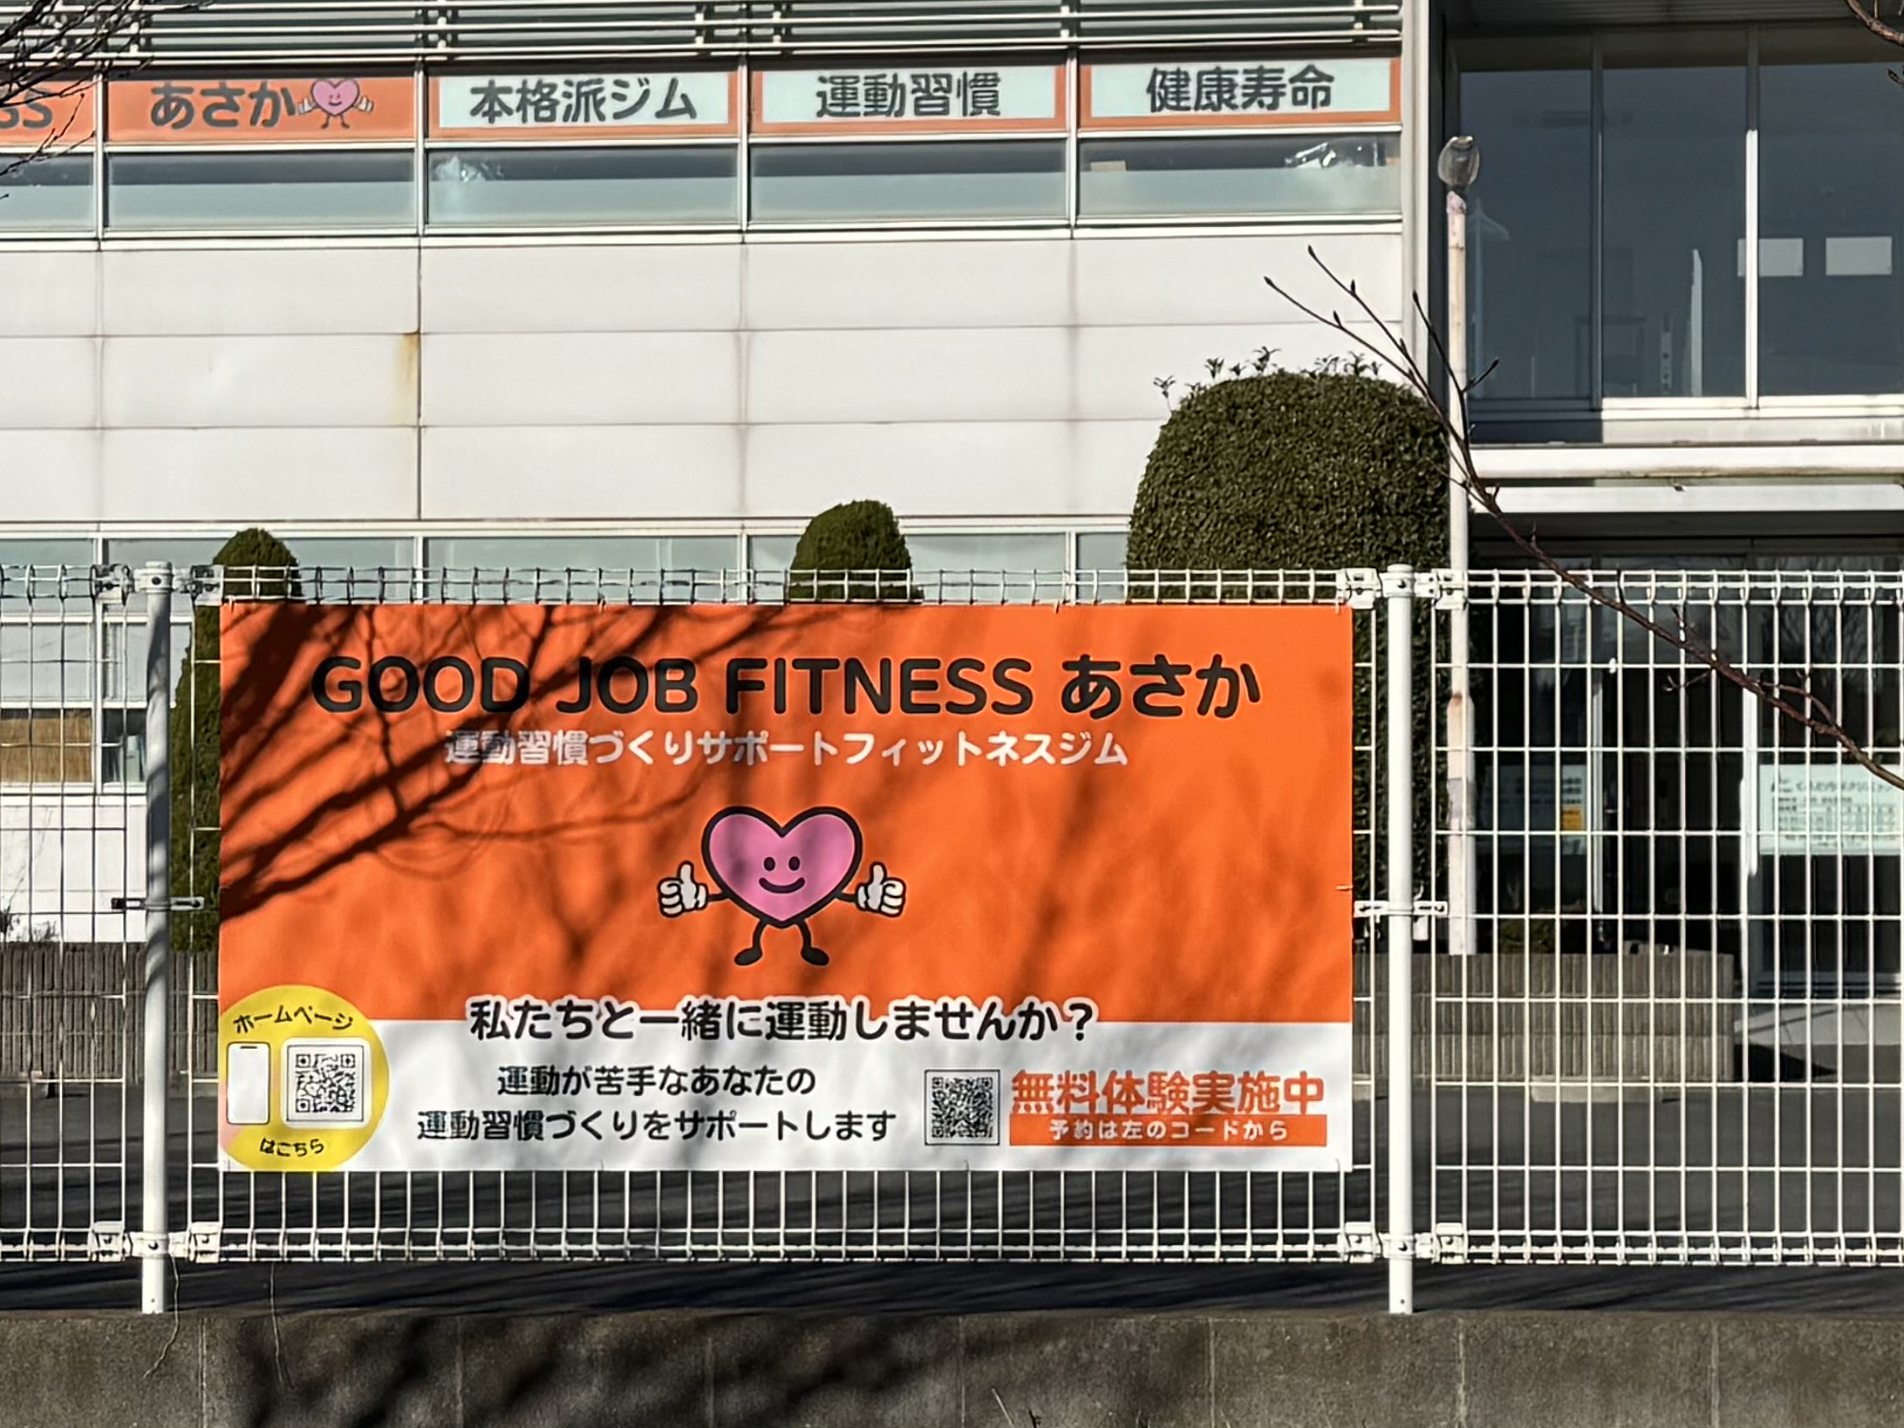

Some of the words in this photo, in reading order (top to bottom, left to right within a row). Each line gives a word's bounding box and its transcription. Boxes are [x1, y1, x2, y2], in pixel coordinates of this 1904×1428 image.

[150, 79, 296, 129] あさか
[470, 78, 697, 124] 本格派ジム
[816, 72, 1002, 118] 運動習慣
[1146, 64, 1335, 113] 健康寿命
[311, 656, 530, 714] GOOD
[556, 656, 698, 714] JOB
[726, 657, 1033, 715] FITNESS
[1061, 653, 1261, 720] あさか
[445, 729, 1128, 767] 運動習慣づくりサポートフィットネスジム
[233, 1005, 354, 1034] ホームページ
[497, 1065, 816, 1097] 運動が苦手なあなたの
[1011, 1069, 1325, 1115] 無料体験実施中
[417, 1109, 896, 1142] 運動習慣づくりをサポートします
[1049, 1119, 1289, 1141] 予約は左のコードから
[260, 1137, 325, 1157] はこちら
